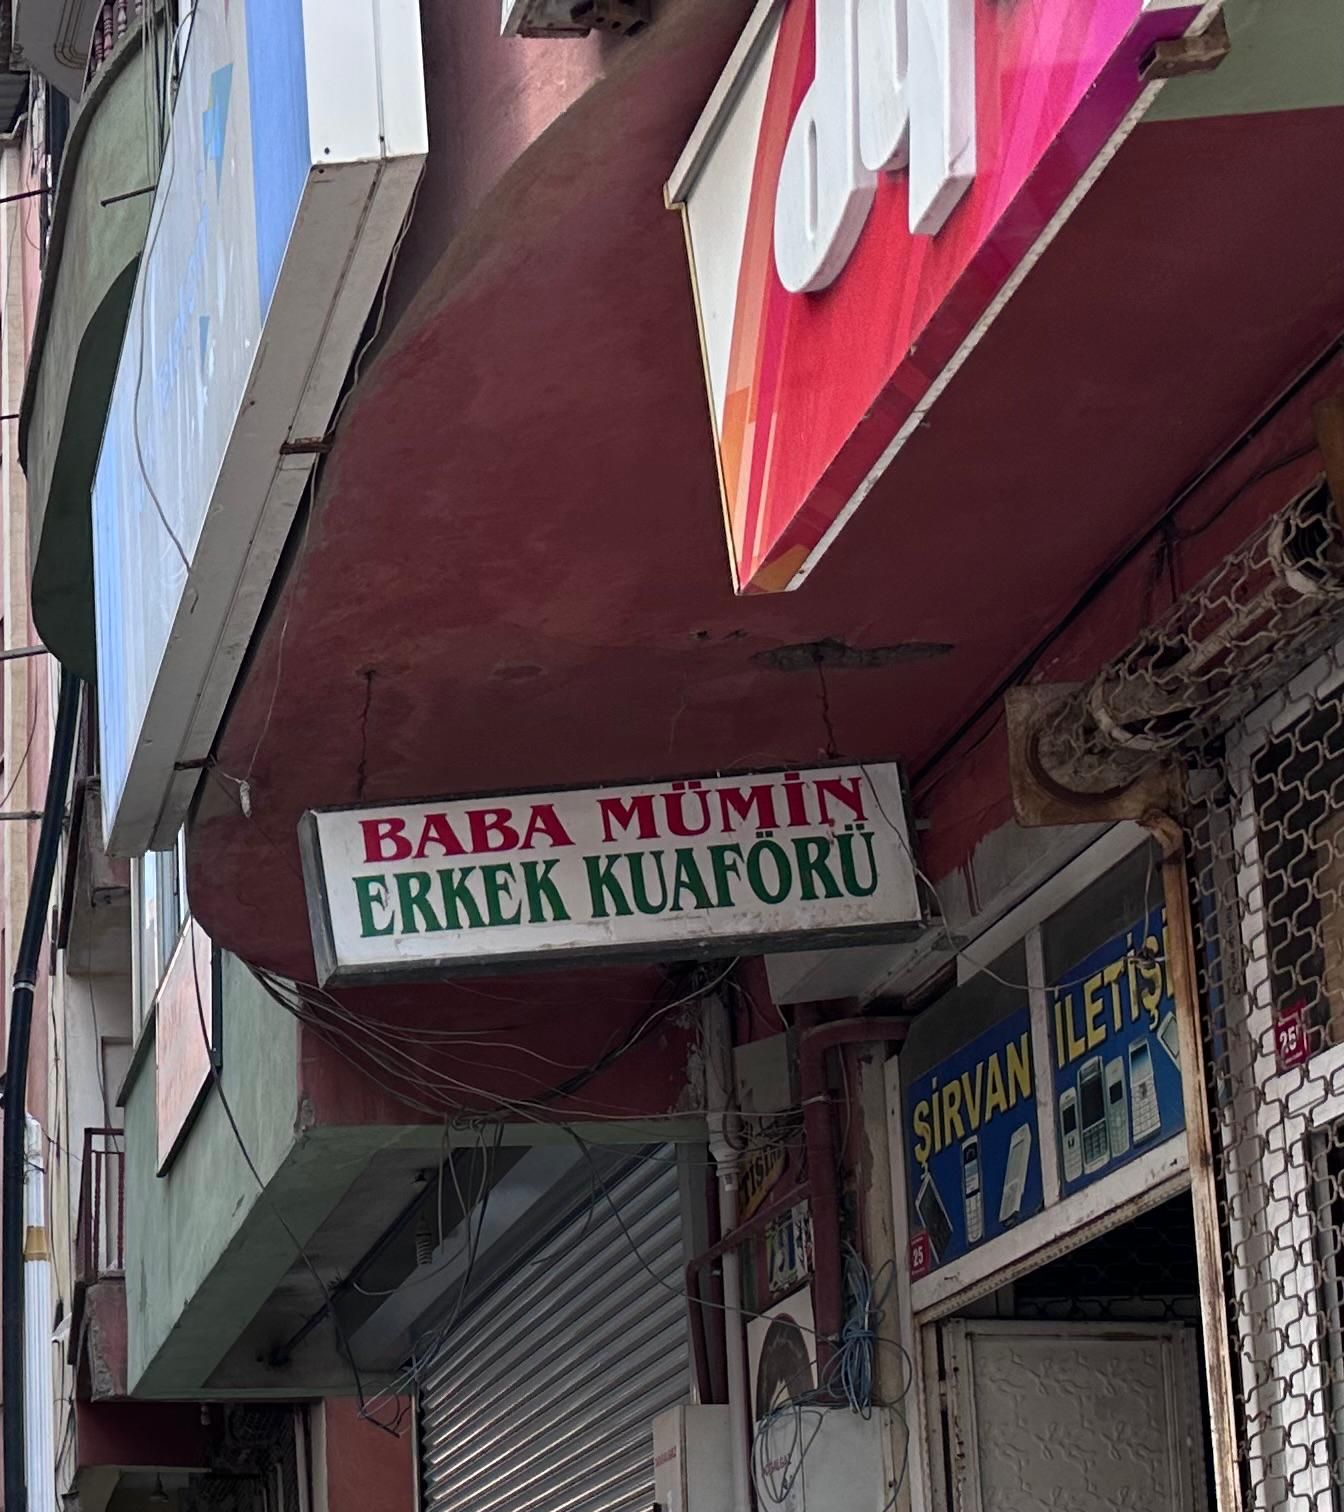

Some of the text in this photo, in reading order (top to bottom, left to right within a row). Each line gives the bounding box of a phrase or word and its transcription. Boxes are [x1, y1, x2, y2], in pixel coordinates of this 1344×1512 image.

[358, 772, 870, 863] BABA MÜMİN
[351, 823, 879, 938] ERKEK KUAFÖRÜ
[1279, 1025, 1297, 1054] 25
[913, 1031, 1033, 1180] ŞİRVAN
